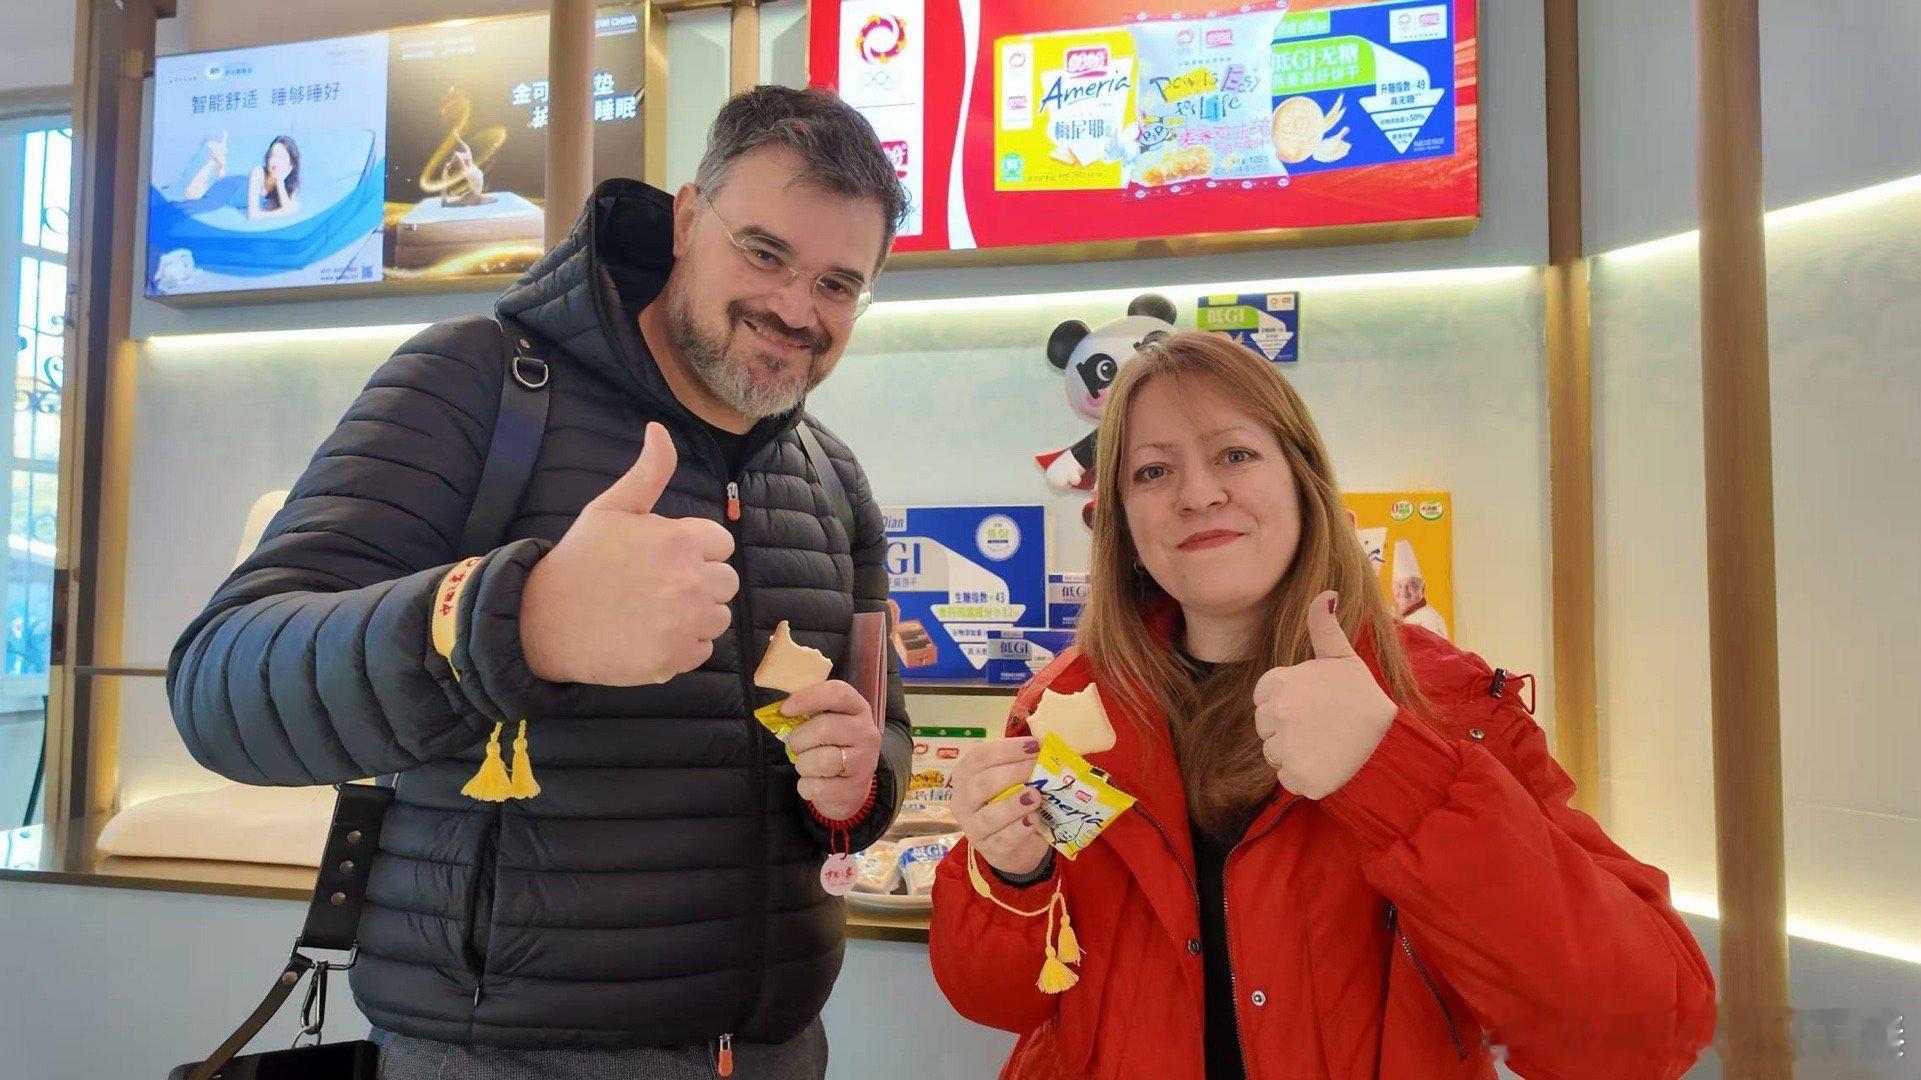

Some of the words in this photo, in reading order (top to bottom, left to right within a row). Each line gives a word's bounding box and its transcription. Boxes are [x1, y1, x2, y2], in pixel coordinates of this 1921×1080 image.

[191, 88, 258, 115] 智能舒适
[271, 82, 341, 107] 睡够睡好
[1040, 70, 1131, 113] Ameria
[594, 96, 636, 121] 睡眠
